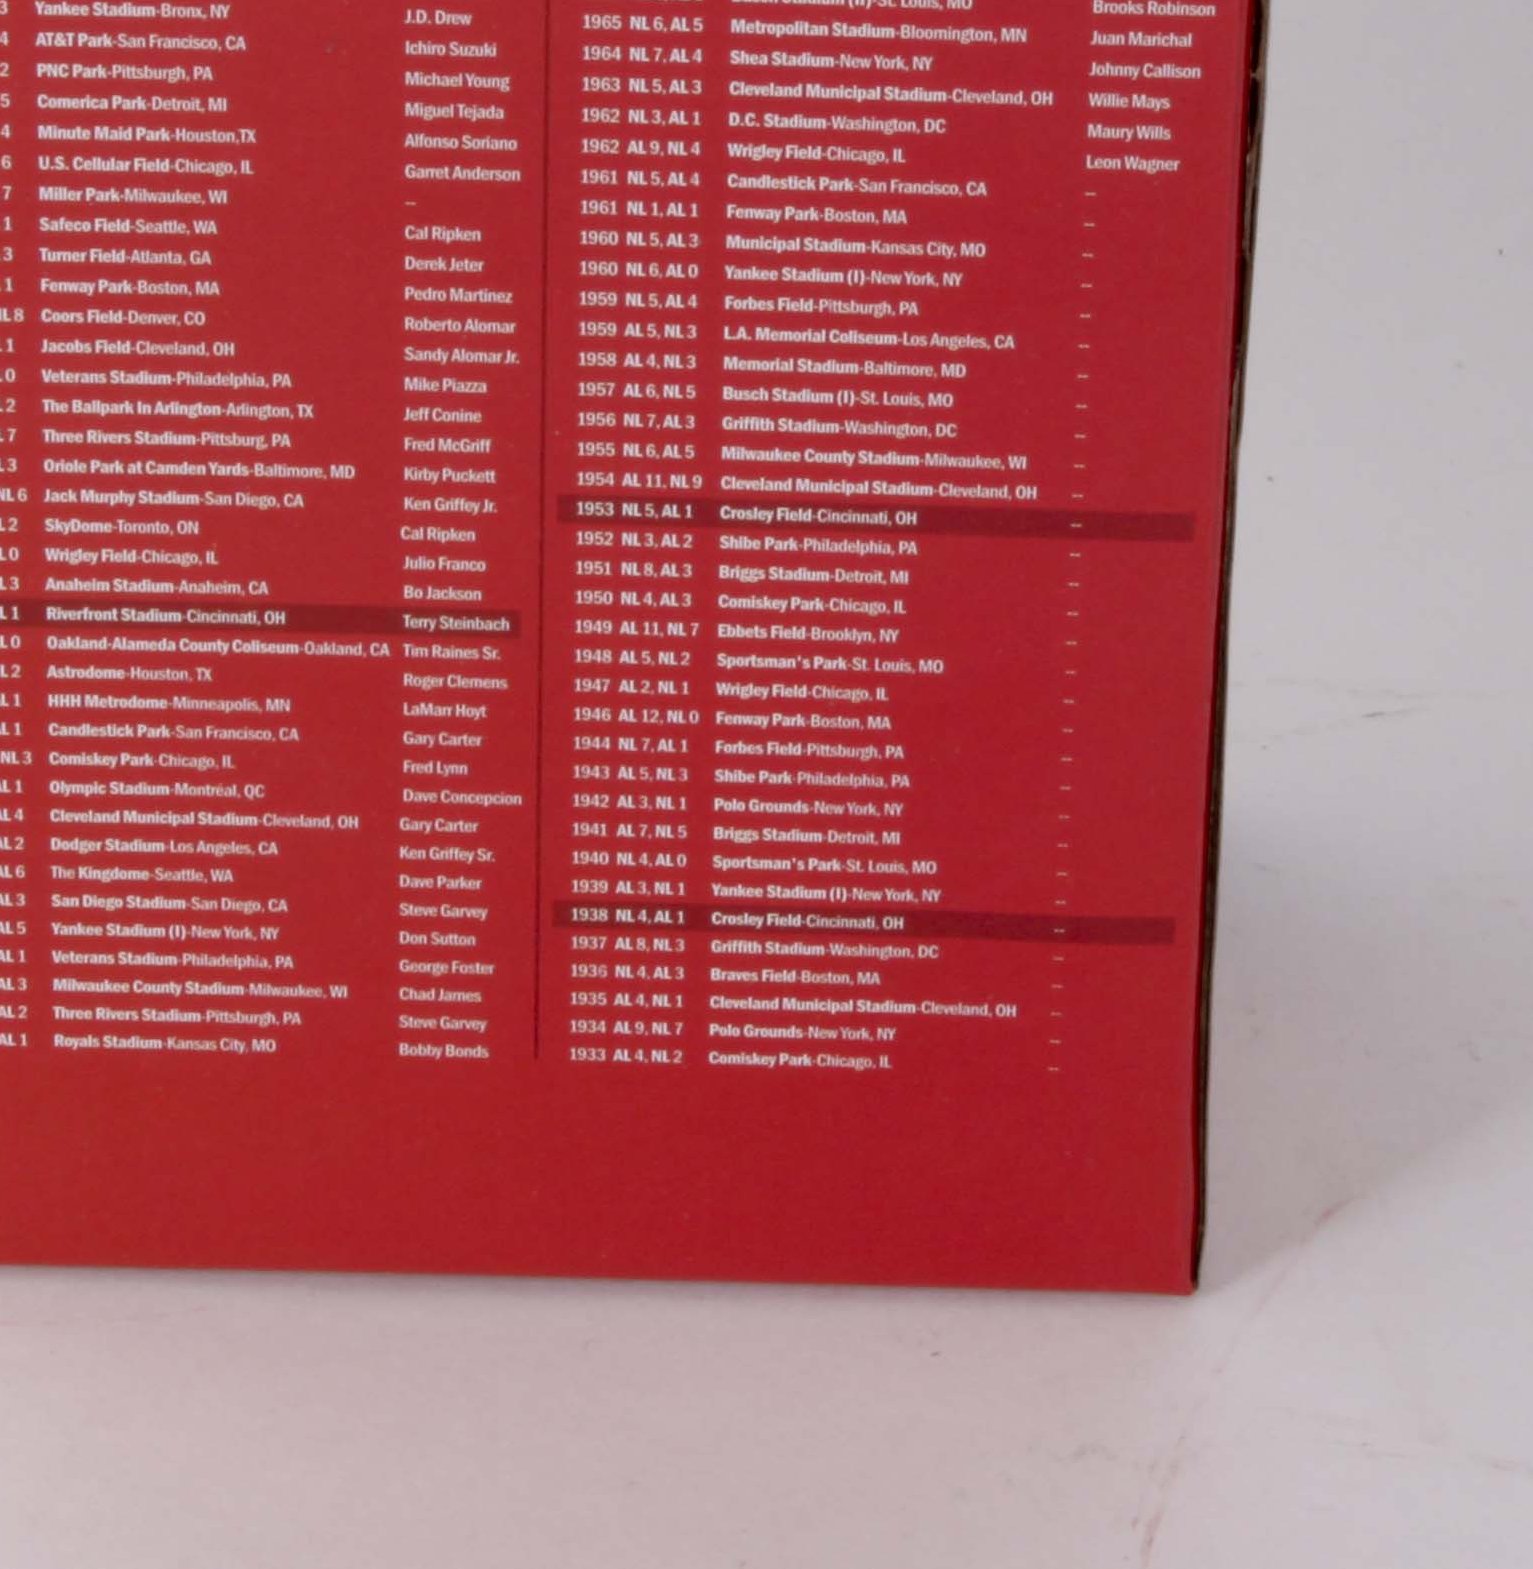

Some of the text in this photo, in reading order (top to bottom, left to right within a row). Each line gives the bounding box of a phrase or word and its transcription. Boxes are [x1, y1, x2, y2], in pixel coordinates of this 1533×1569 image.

[582, 13, 623, 31] 1965
[730, 18, 830, 38] Metropolitan
[1000, 27, 1028, 43] MN
[1089, 30, 1193, 48] Juan Marichal
[35, 62, 71, 79] PNC
[192, 65, 214, 81] PA
[404, 70, 511, 93] Michael Young
[581, 107, 621, 124] 1962
[923, 117, 947, 134] DC
[1086, 122, 1172, 143] Maury Wills
[71, 155, 132, 173] Cellular
[240, 159, 255, 175] IL
[403, 163, 522, 182] Garret Anderson
[39, 277, 97, 297] Fenway
[194, 280, 221, 296] MA
[403, 285, 514, 304] Pedro Martinez
[579, 290, 619, 307] 1959
[723, 294, 776, 312] Forbes
[898, 300, 919, 316] PA
[40, 368, 109, 385] Veterans
[271, 372, 293, 388] PA
[403, 375, 488, 394] Mike Piazza
[576, 500, 615, 517] 1953
[719, 504, 775, 524] Crosley
[894, 510, 918, 526] OH
[176, 519, 200, 536] ON
[399, 525, 477, 544] Cal Ripken
[45, 605, 120, 622] Riverfront
[263, 609, 286, 626] OH
[402, 613, 511, 632] Terry Steinbach
[574, 618, 614, 635] 1949
[716, 622, 769, 640] Ebbets
[878, 628, 900, 644] NY
[48, 750, 119, 769] Comiskey
[221, 754, 235, 769] IL
[402, 758, 469, 778] Fred Lynn
[571, 907, 610, 923] 1938
[710, 910, 765, 930] Crosley
[881, 915, 905, 930] OH
[53, 1033, 101, 1051] Royals
[251, 1038, 277, 1053] MO
[398, 1041, 490, 1060] Bobby Bonds
[569, 1046, 607, 1062] 1933
[707, 1050, 778, 1069] Comiskey
[878, 1054, 892, 1069] IL
